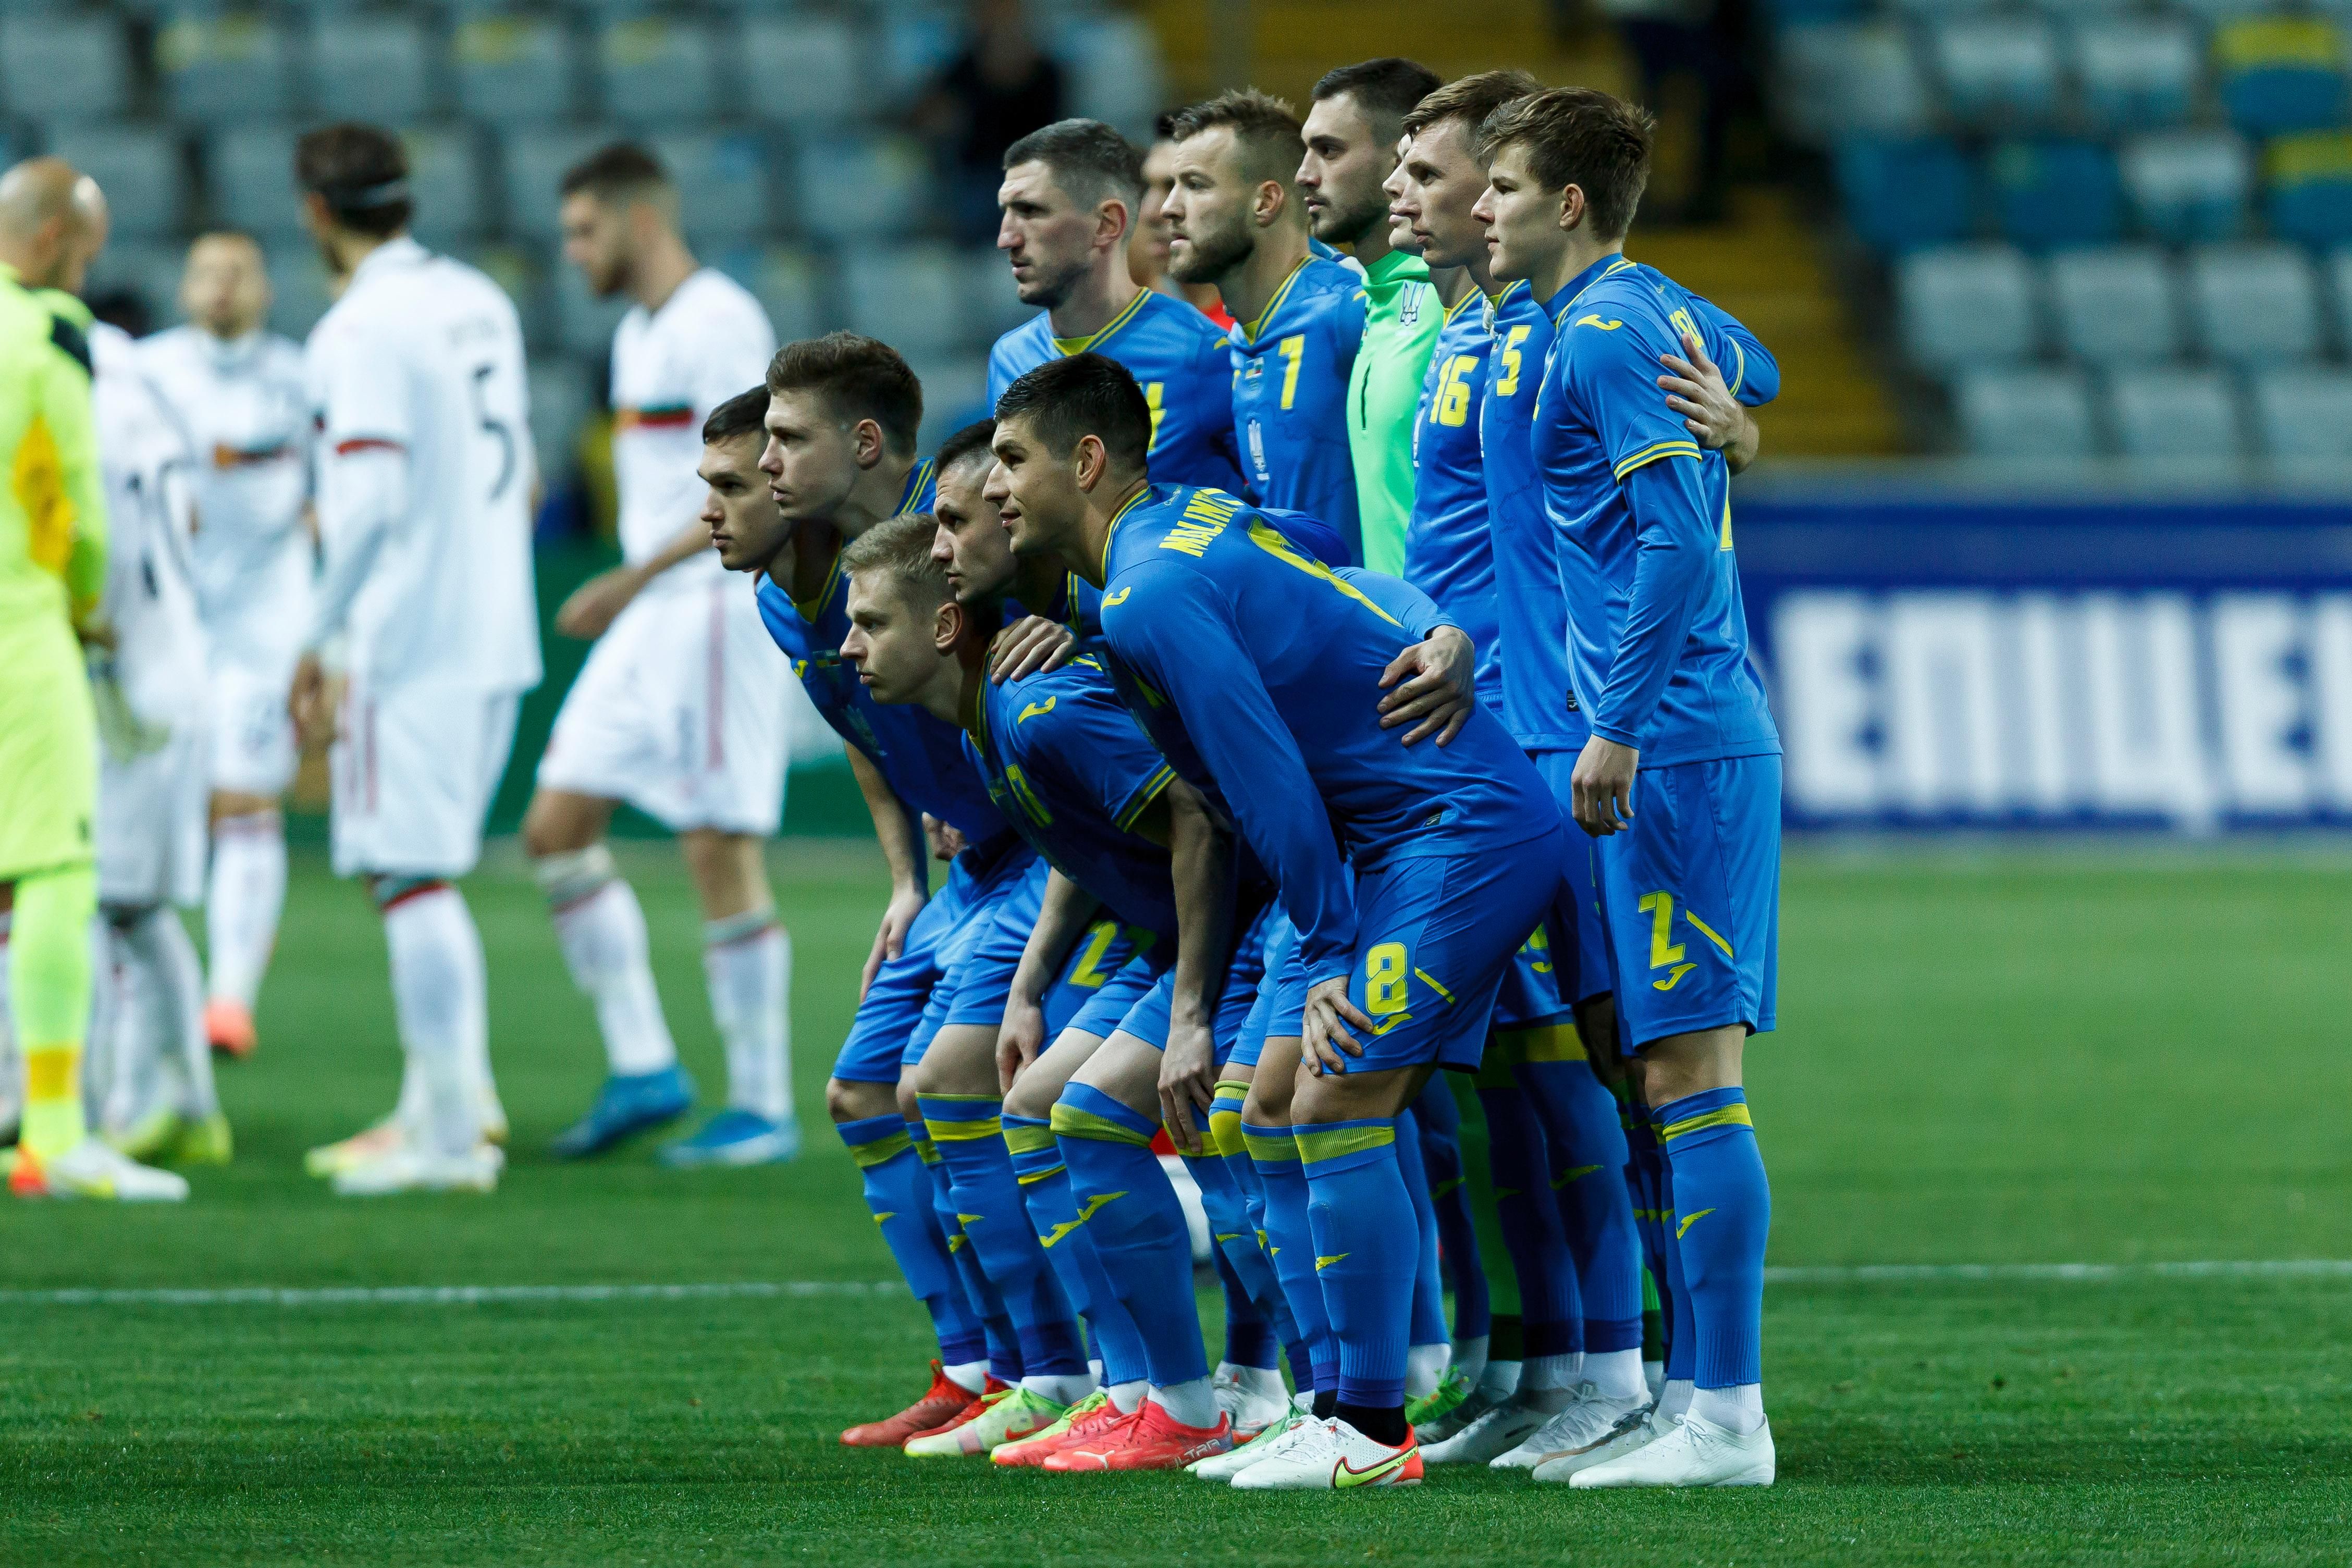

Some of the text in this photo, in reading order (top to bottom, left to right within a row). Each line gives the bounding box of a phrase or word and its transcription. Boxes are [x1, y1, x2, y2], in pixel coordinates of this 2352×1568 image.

[1278, 334, 1304, 410] 7
[1429, 355, 1480, 427] 16
[1497, 325, 1530, 397] 5
[1638, 890, 1686, 970] 2
[1364, 942, 1409, 1016] 8
